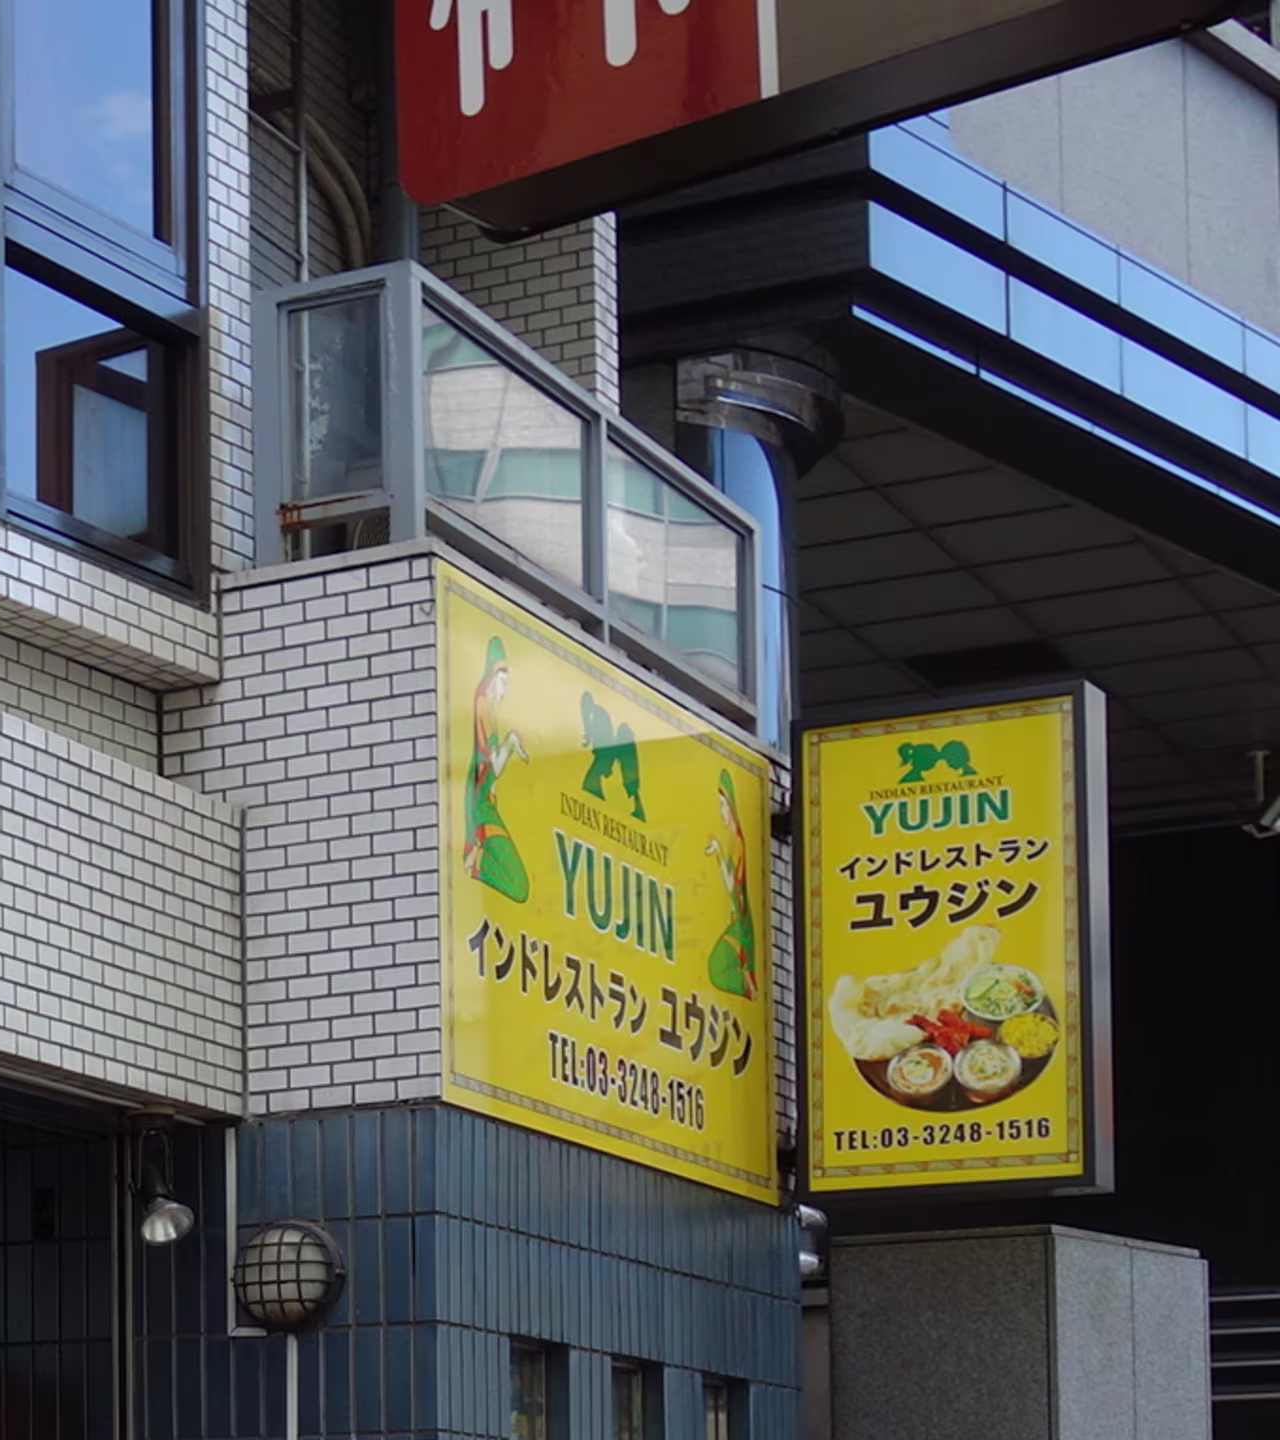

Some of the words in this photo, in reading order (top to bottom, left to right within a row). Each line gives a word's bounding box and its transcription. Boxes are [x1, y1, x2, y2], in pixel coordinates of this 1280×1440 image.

[862, 788, 1011, 836] YUJIN
[870, 786, 917, 800] INDIAN
[920, 776, 1004, 796] RESTAURANT
[559, 792, 602, 832] INDIAN
[602, 816, 669, 866] RESTAURANT
[839, 839, 1049, 881] インドレストラン
[553, 827, 675, 965] YUJIN
[849, 878, 1039, 931] ユウジン
[468, 918, 648, 1034] インドレストラン
[658, 986, 752, 1077] ユウジン
[548, 1031, 705, 1132] TEL:03-3248-1516
[833, 1117, 1052, 1151] TEL:03-3248-1516
